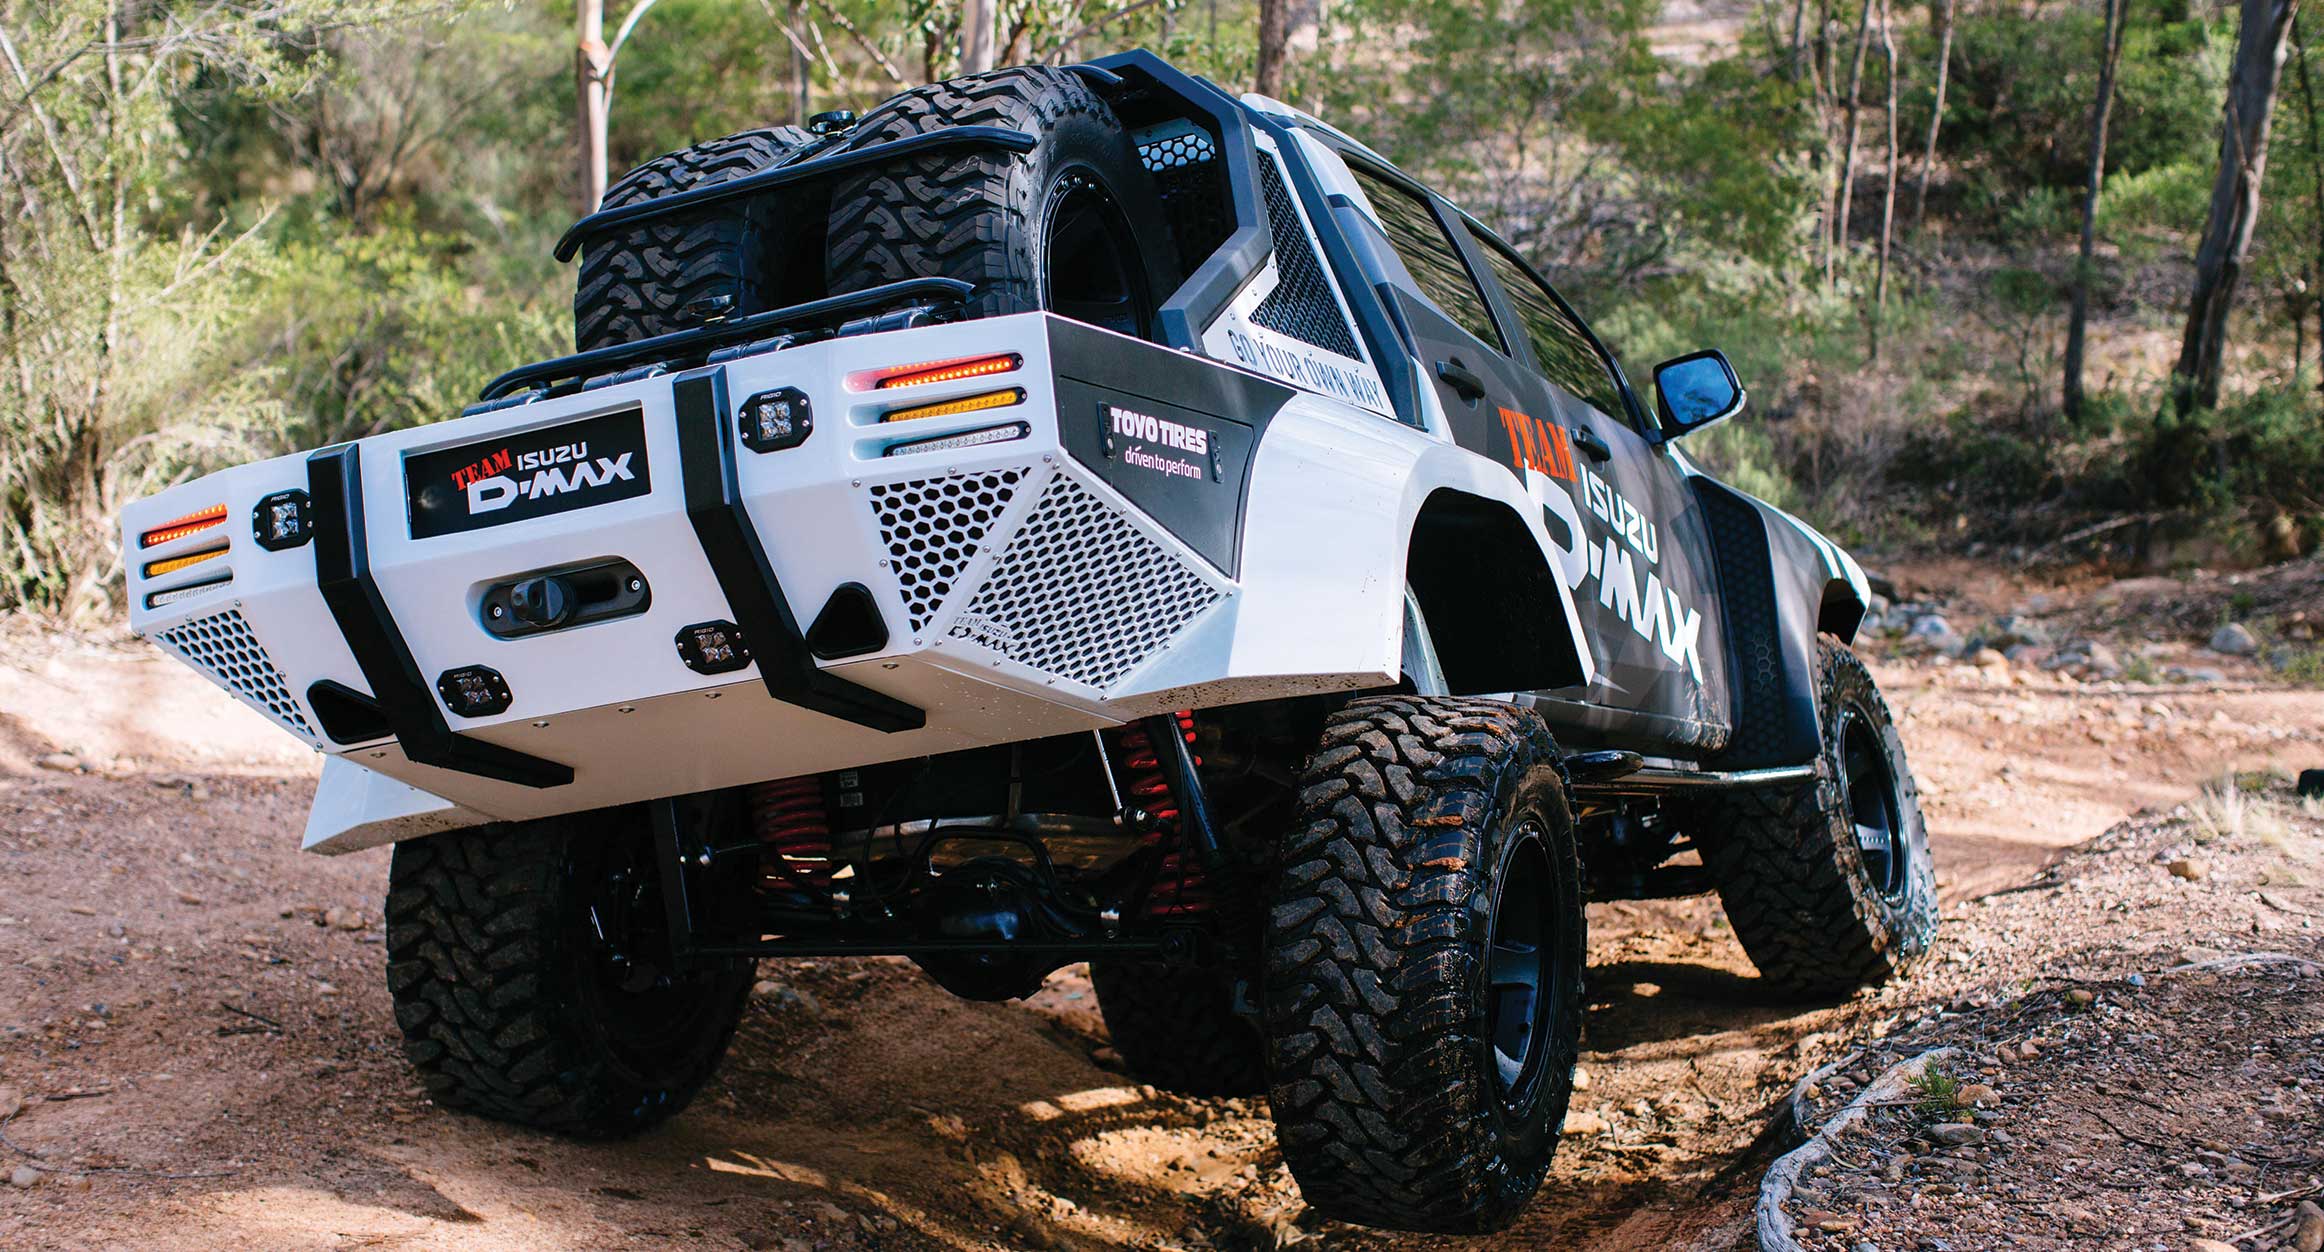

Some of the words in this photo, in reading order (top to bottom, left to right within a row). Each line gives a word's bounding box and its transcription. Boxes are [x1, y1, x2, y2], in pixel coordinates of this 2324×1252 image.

[1228, 329, 1257, 366] GO
[1253, 339, 1308, 384] YOUR
[1304, 357, 1349, 397] OWN
[1344, 370, 1384, 408] WAY
[516, 441, 587, 471] ISUZU
[1110, 407, 1159, 442] TOYO
[1159, 419, 1207, 455] TIRES
[1498, 406, 1577, 483] TEAM
[451, 448, 513, 491] TEAM
[467, 452, 635, 515] D-MAX
[1125, 445, 1154, 469] driven
[1155, 454, 1165, 472] to
[1166, 459, 1201, 480] perform
[1580, 462, 1658, 564] ISUZU
[1524, 457, 1703, 685] D-MAX
[948, 626, 1015, 654] D-MAX
